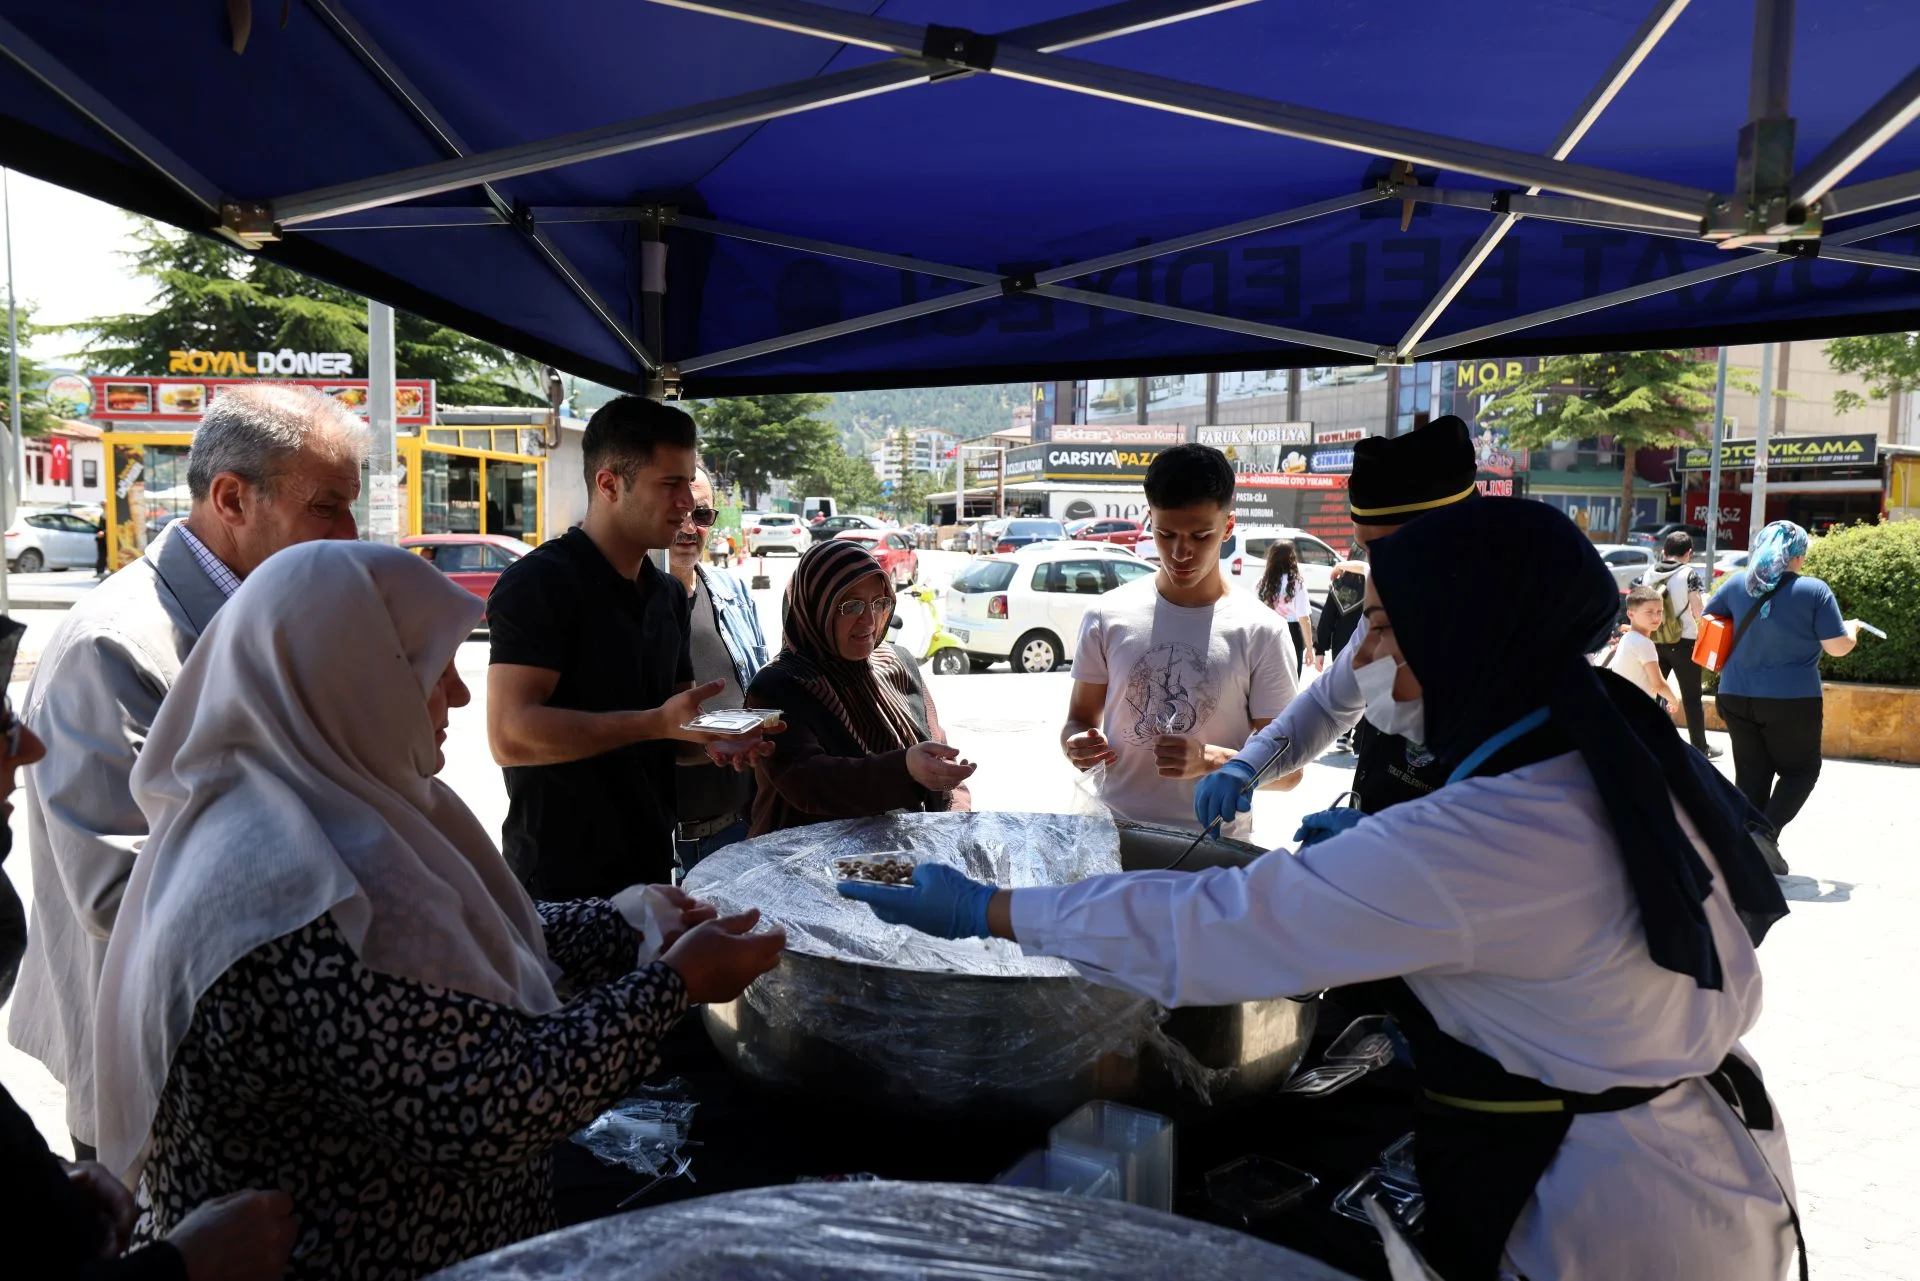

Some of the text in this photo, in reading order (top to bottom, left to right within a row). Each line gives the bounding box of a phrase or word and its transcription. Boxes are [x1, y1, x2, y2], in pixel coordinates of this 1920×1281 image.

[169, 348, 353, 375] ROYAL DÖNER
[1200, 426, 1307, 444] FARUK MOBİLYA
[1766, 440, 1865, 457] YIKAMA
[1049, 451, 1115, 467] ÇARŞIYA
[1290, 477, 1306, 485] OTO
[1307, 477, 1333, 487] YIKAMA
